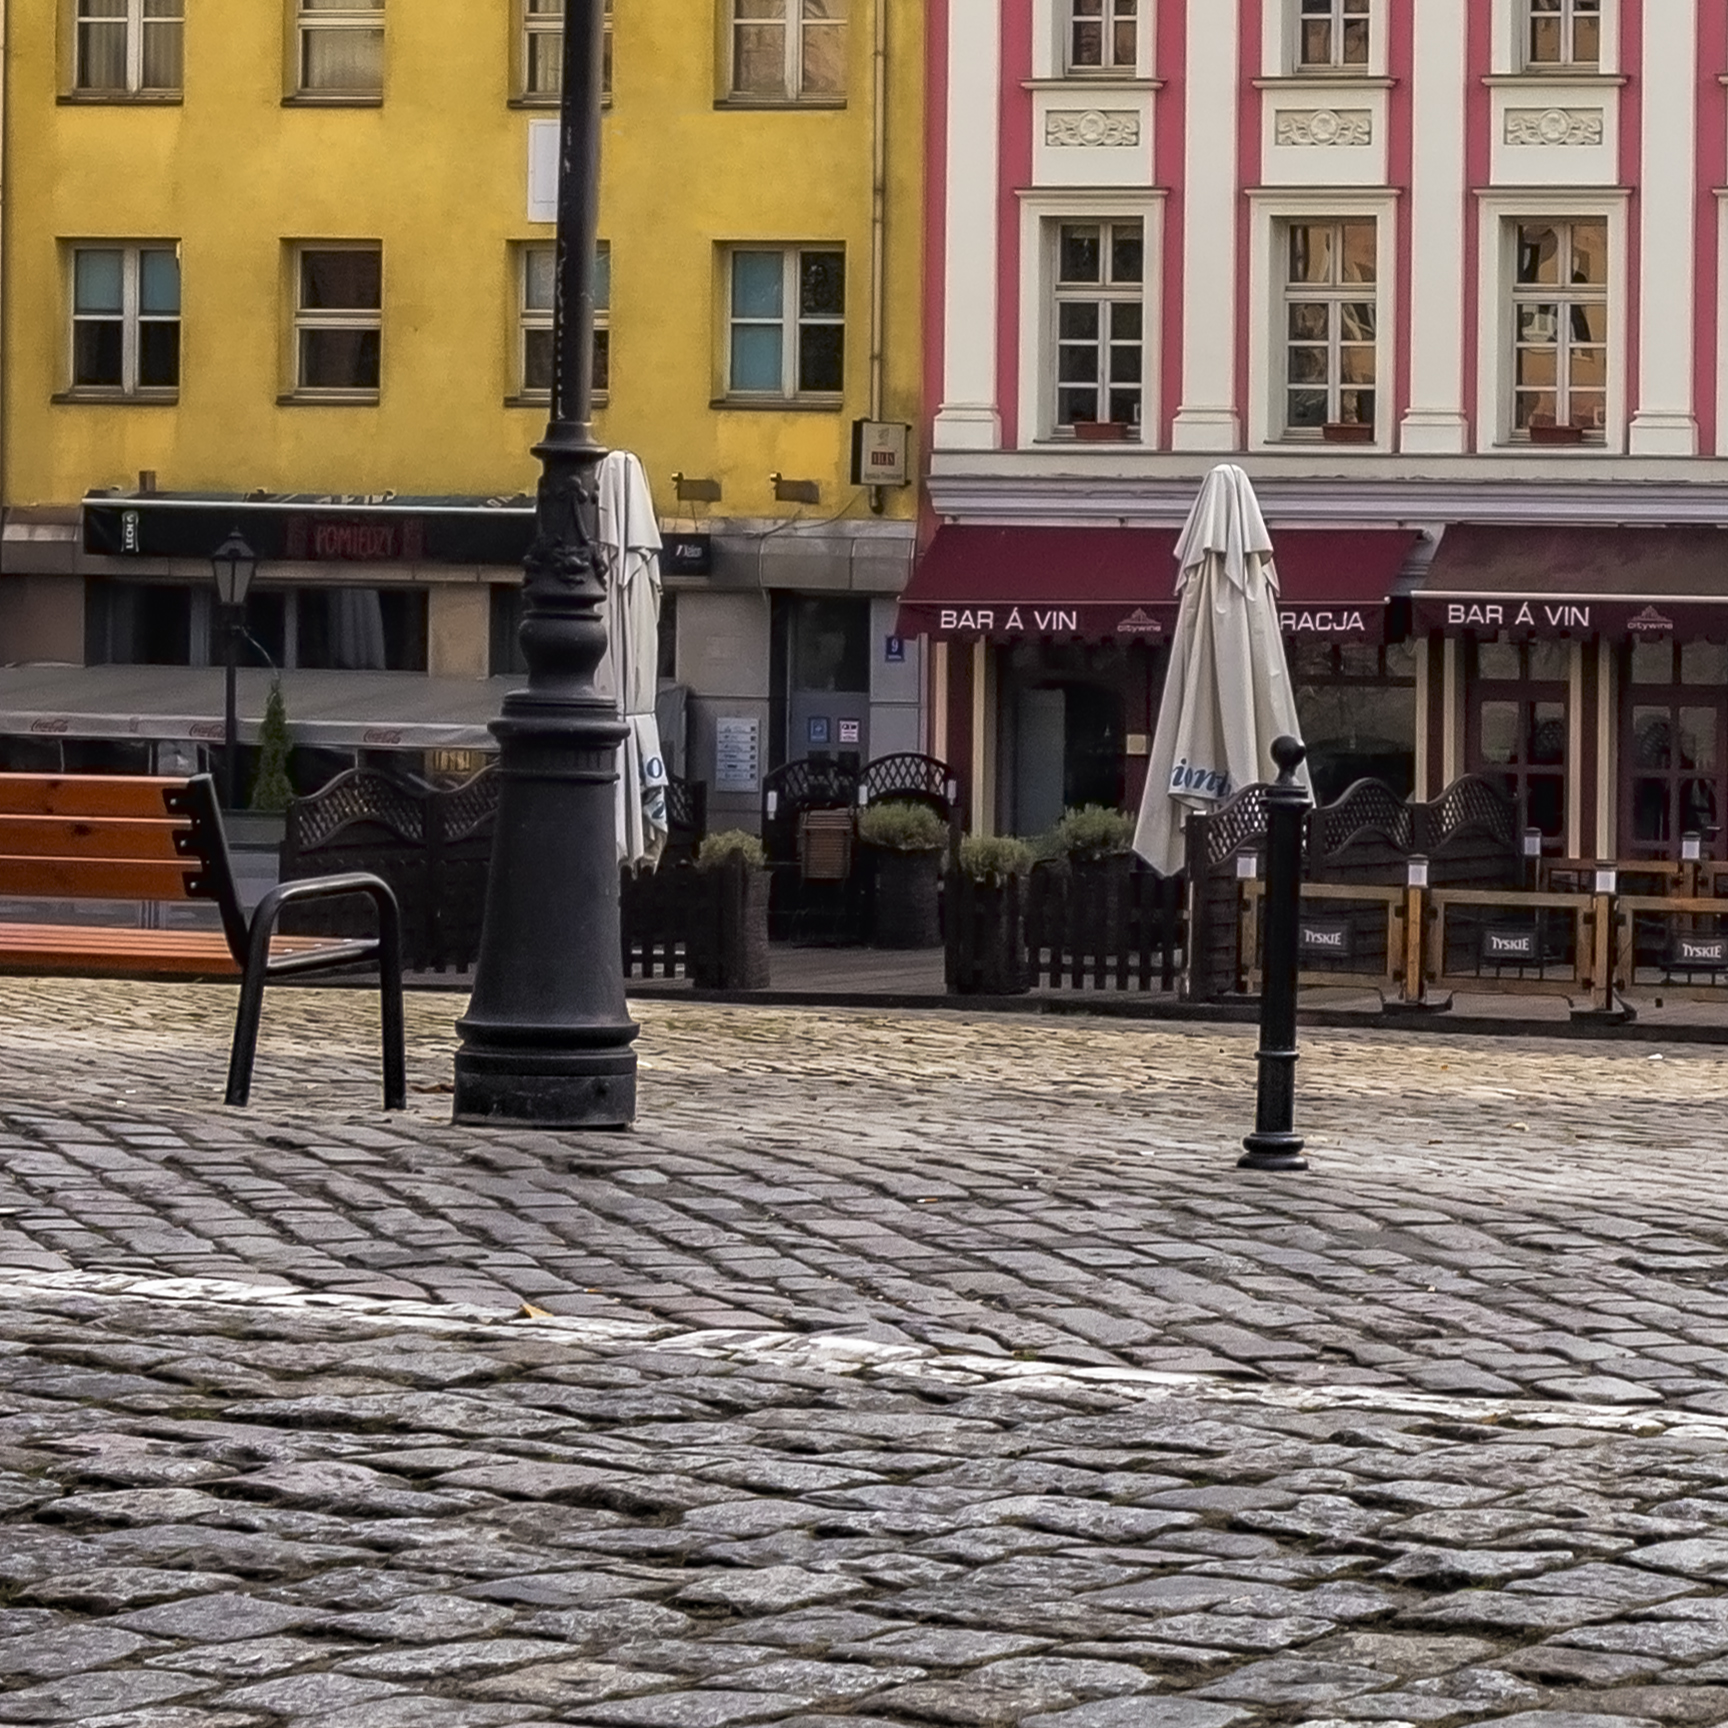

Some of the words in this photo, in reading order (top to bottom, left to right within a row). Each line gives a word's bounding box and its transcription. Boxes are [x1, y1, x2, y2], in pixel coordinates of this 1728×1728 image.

[126, 523, 134, 550] LECH
[940, 610, 994, 629] BAR
[1033, 611, 1077, 631] VIN
[1447, 604, 1503, 624] BAR
[1544, 606, 1590, 627] VIN
[891, 638, 899, 653] 9
[1304, 929, 1341, 945] TYSKIE
[1491, 936, 1529, 951] TYSKIE
[1682, 943, 1722, 959] TYSKIE
